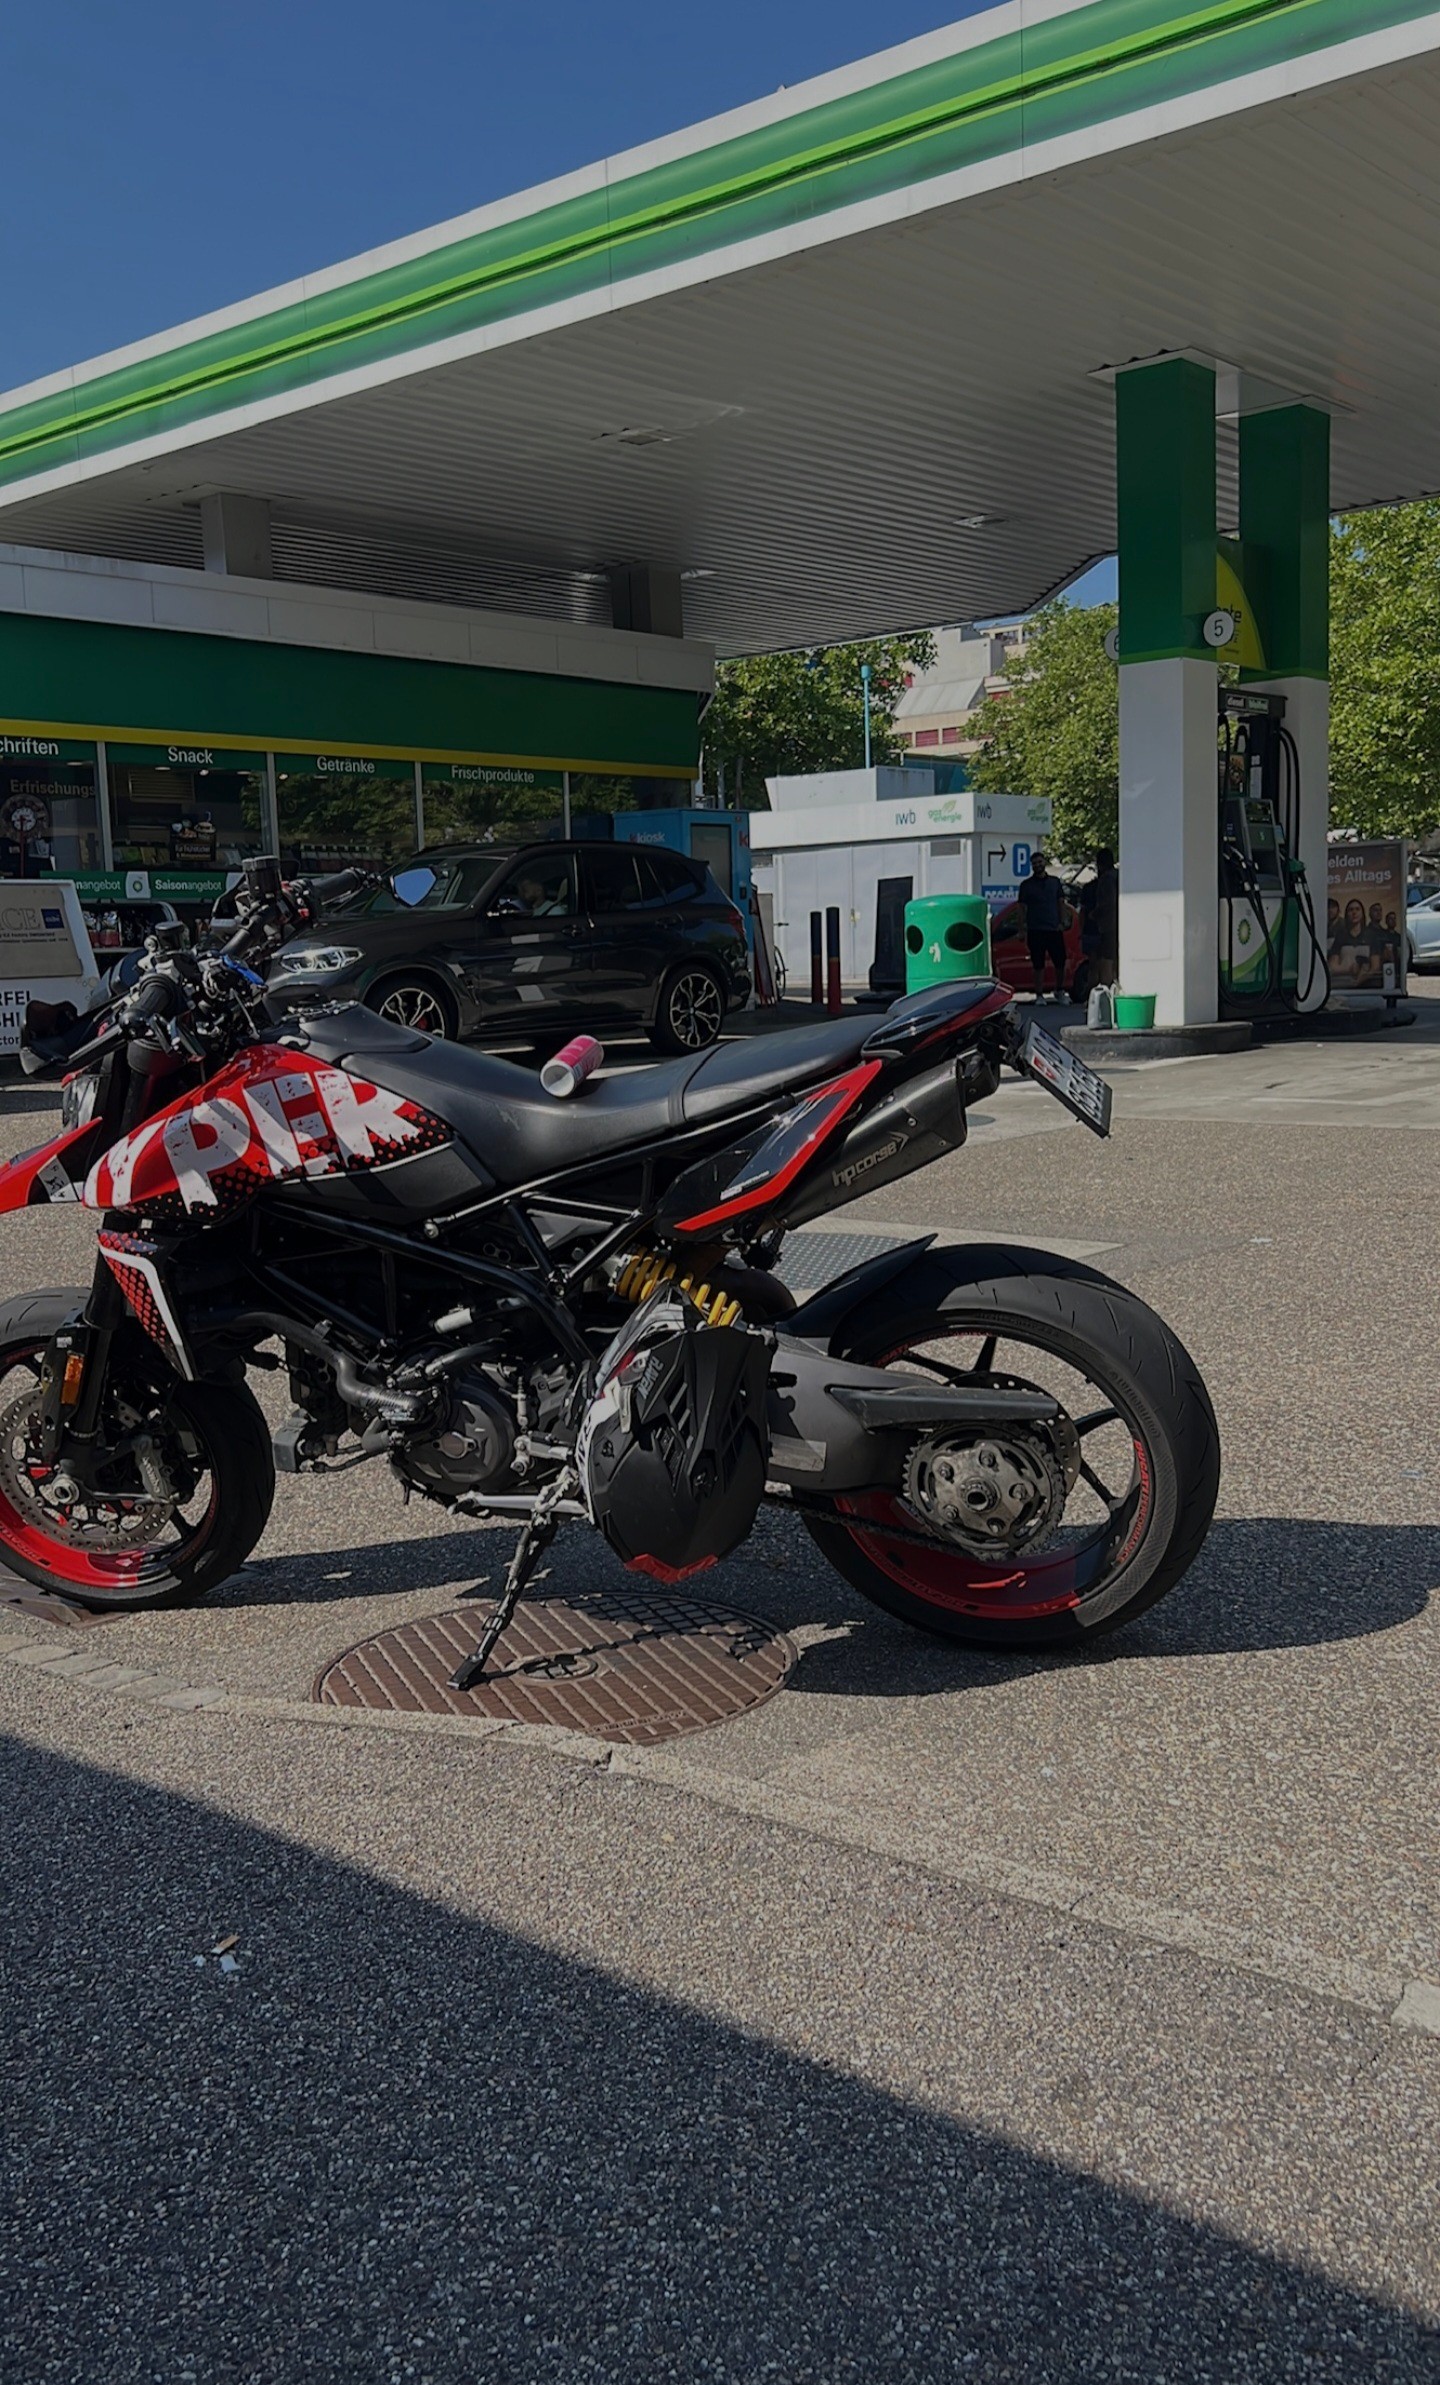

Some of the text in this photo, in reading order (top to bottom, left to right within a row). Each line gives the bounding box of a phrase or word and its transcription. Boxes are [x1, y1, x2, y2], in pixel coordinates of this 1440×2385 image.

[1214, 619, 1224, 637] 5
[167, 746, 214, 764] Snack
[316, 756, 375, 774] Getränke
[451, 765, 534, 783] Frischprodukte
[1017, 847, 1026, 874] P
[155, 879, 222, 892] Saisonangebot
[1345, 869, 1391, 884] Alltags
[1116, 1440, 1150, 1564] DUCATI PERFORMANCE
